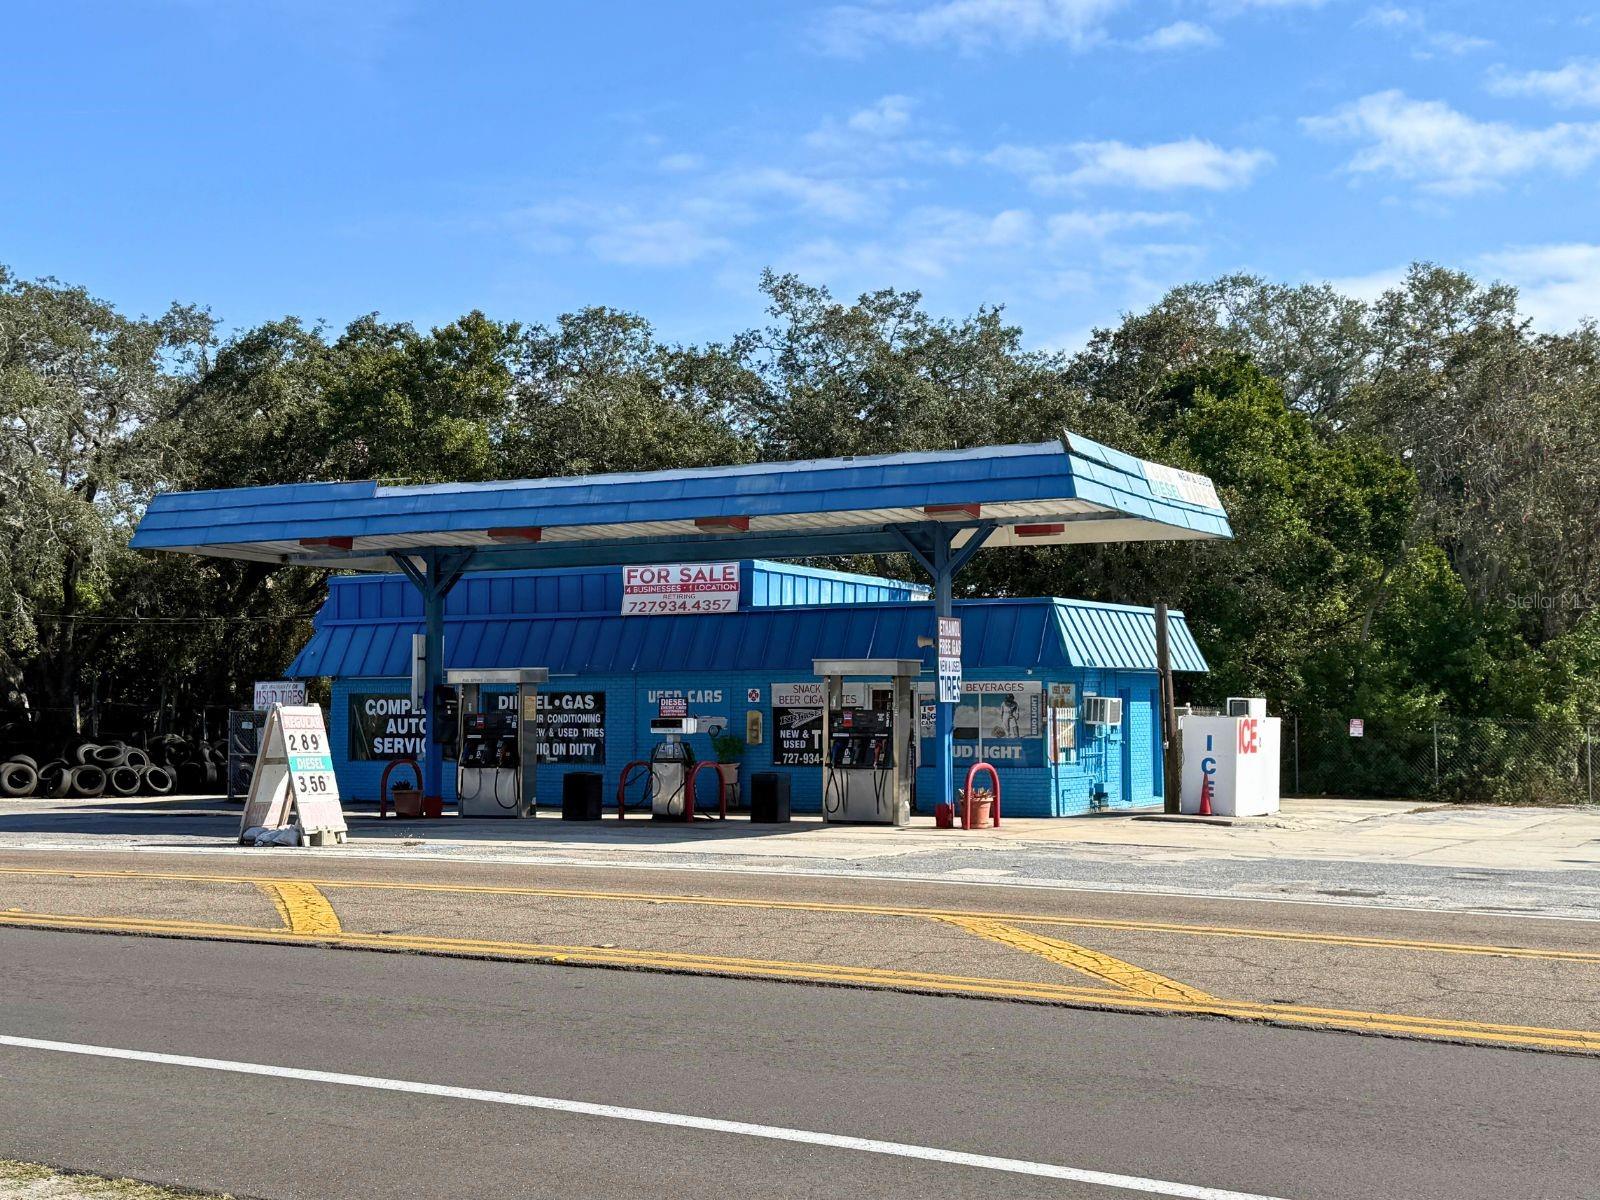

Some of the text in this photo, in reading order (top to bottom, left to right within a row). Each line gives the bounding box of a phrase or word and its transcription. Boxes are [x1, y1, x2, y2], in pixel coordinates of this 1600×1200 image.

[627, 565, 736, 585] FOR SALE
[633, 585, 682, 593] BUSINESSES
[695, 583, 737, 592] LOCATION
[628, 599, 731, 613] 727.934.4357
[939, 638, 951, 655] FREE
[939, 675, 961, 701] TIRES
[965, 683, 1024, 692] BEVERAGES
[256, 689, 304, 706] USED TIRES
[561, 694, 595, 710] GAS
[660, 698, 687, 706] DIESEL
[687, 690, 723, 703] CARS
[778, 695, 801, 705] BEER
[1030, 695, 1039, 719] LIGHT
[547, 713, 601, 723] CONDITIONING
[548, 727, 555, 738] &
[558, 728, 579, 738] USED
[582, 727, 605, 738] TIRES
[780, 729, 810, 739] NEW &
[1238, 719, 1258, 754] ICE
[552, 743, 567, 756] ON
[569, 742, 596, 757] DUTY
[783, 740, 807, 749] USED
[953, 745, 1022, 759] UD LIGHT
[297, 758, 324, 769] DIESEL
